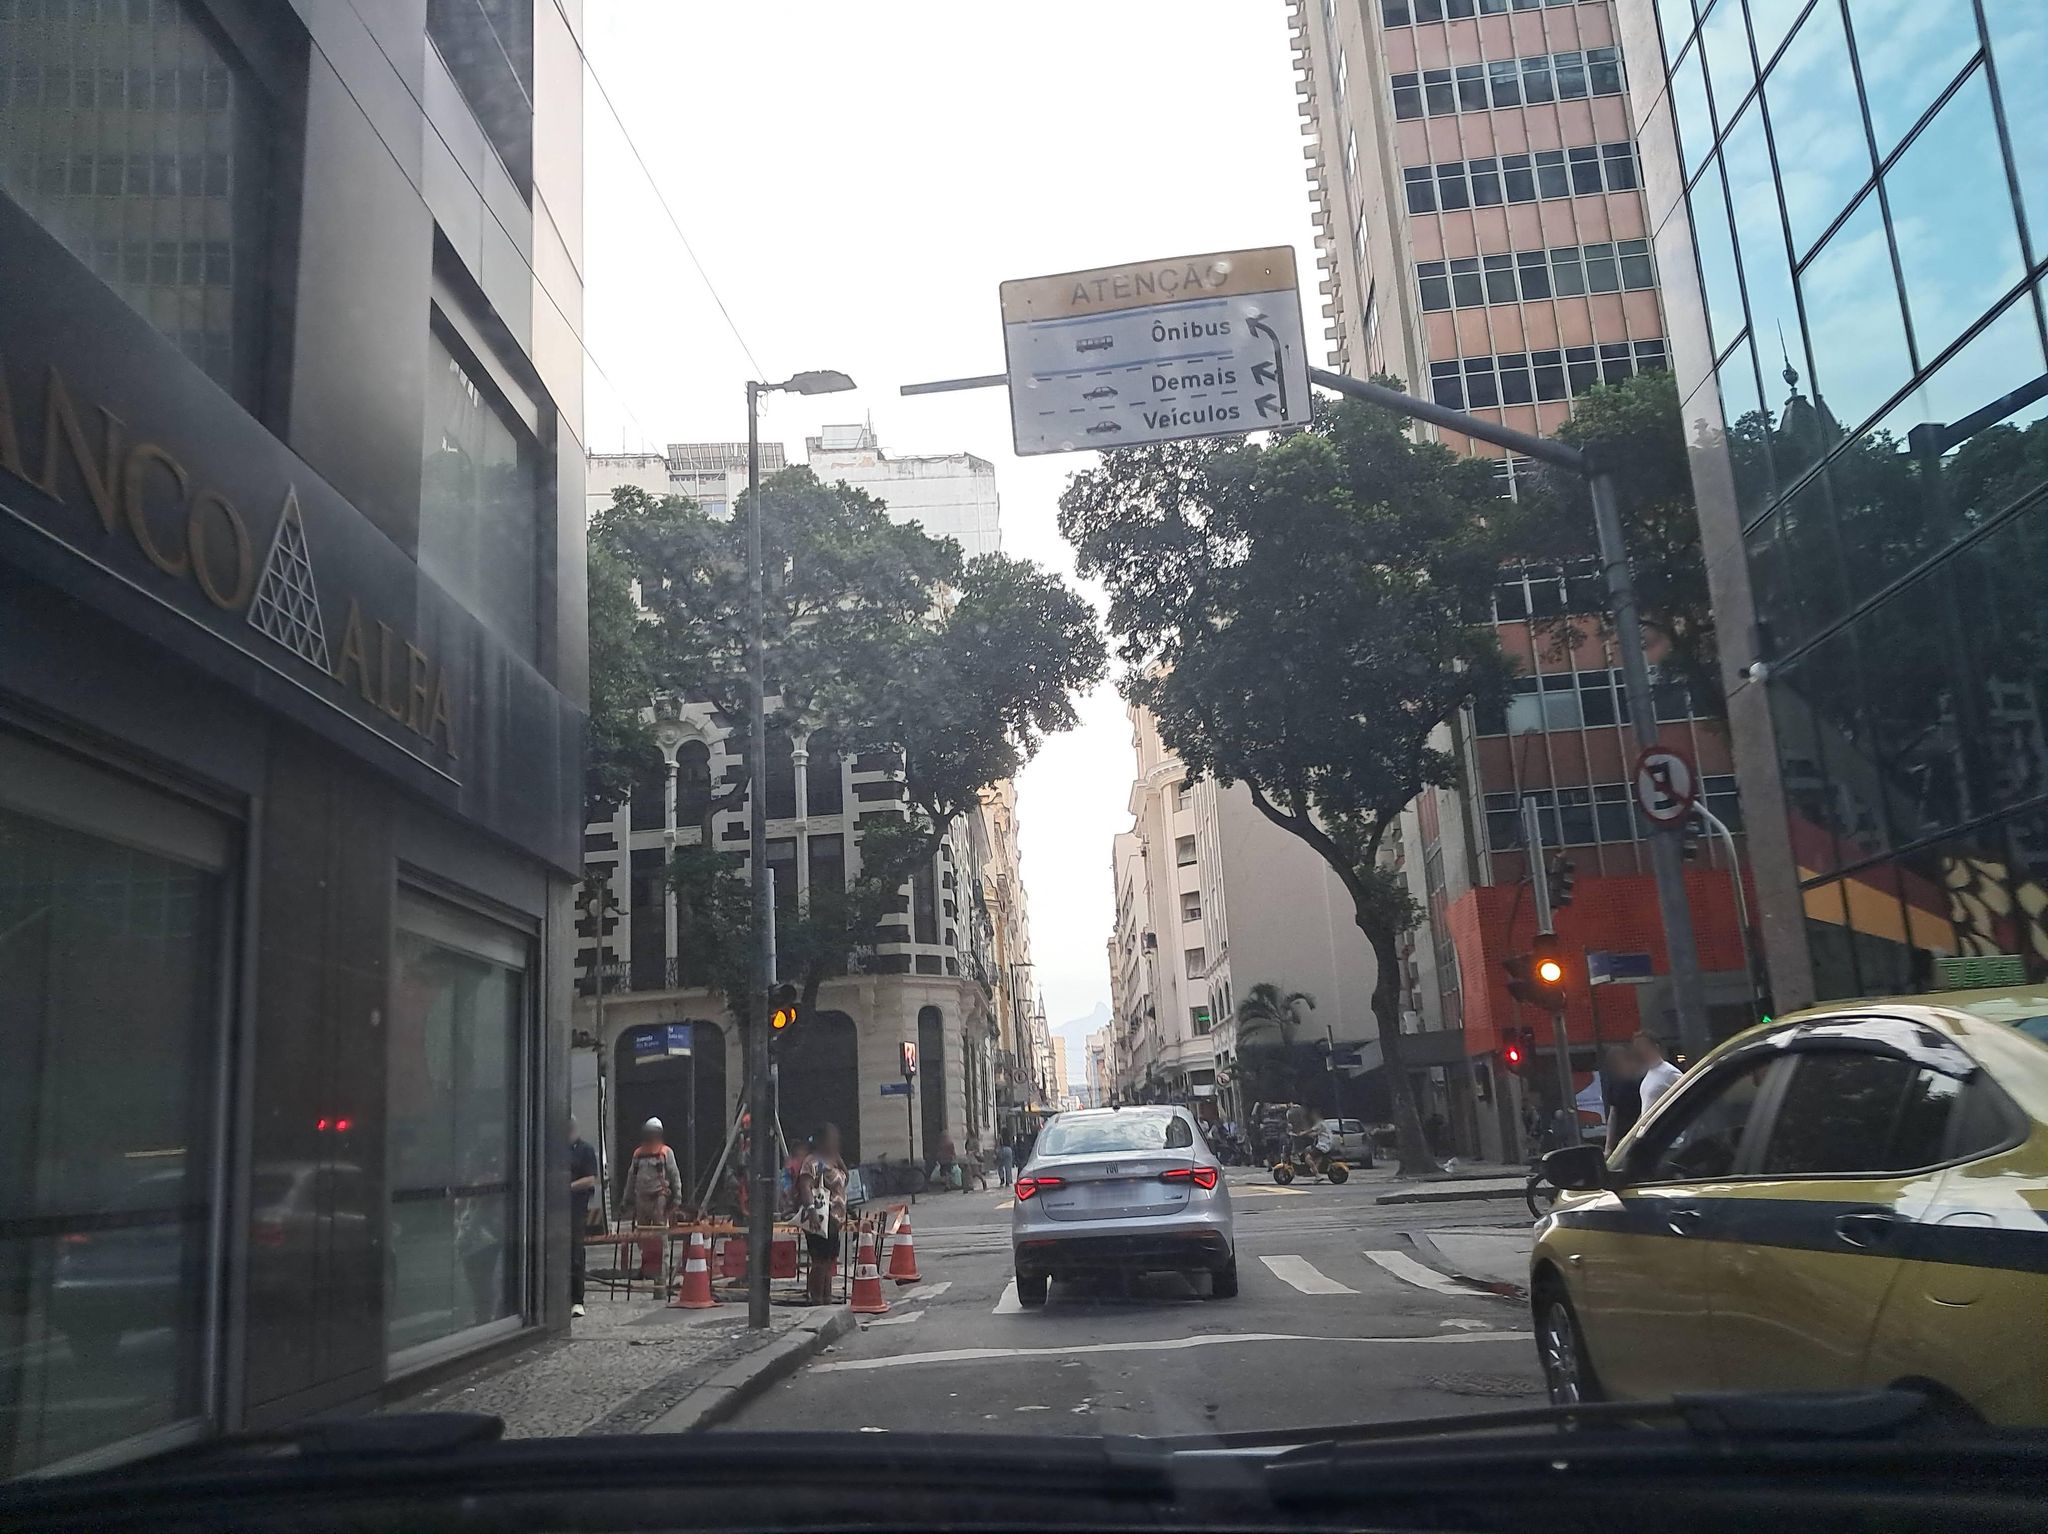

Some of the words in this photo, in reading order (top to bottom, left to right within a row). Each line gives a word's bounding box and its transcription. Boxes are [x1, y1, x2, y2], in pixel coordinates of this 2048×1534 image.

[1071, 262, 1229, 306] ATENÇÃO
[1152, 319, 1232, 343] Ônibus
[1152, 368, 1237, 392] Demais
[1143, 404, 1240, 430] Veículos
[333, 596, 459, 761] ALFA
